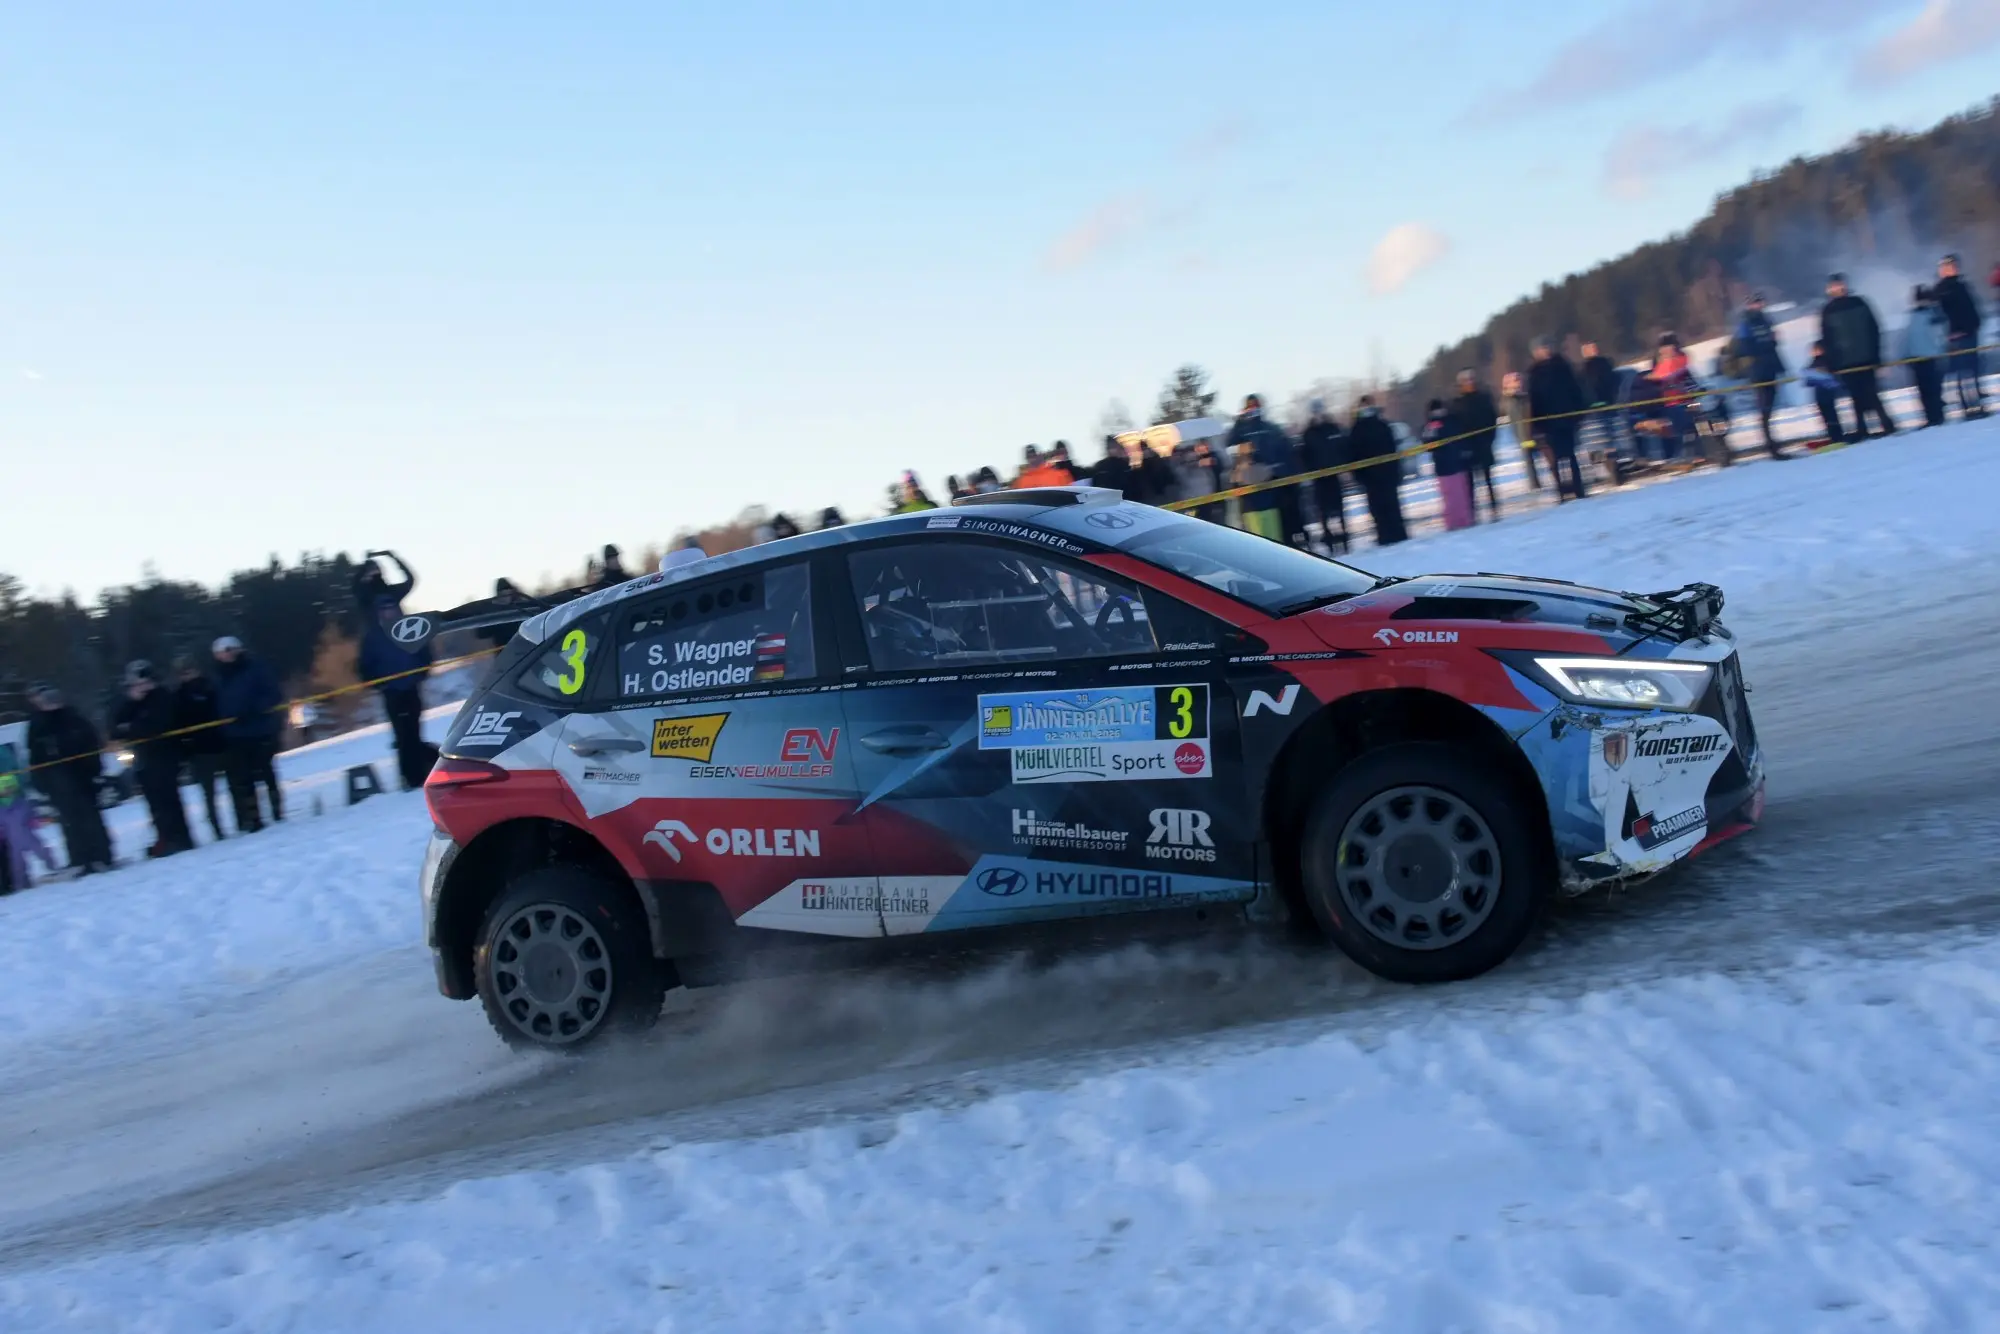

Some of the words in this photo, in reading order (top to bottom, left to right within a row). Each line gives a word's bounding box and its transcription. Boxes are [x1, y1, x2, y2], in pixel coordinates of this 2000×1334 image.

[1403, 631, 1459, 643] ORLEN
[559, 629, 586, 695] 3
[648, 644, 667, 666] S.
[675, 638, 755, 664] Wagner
[624, 674, 645, 695] H.
[652, 664, 755, 691] Ostlender
[1016, 700, 1151, 731] JÄNNERRALLYE
[1168, 687, 1193, 738] 3
[657, 721, 693, 738] inter
[659, 734, 710, 751] wetten
[1112, 753, 1166, 774] Sport
[1665, 753, 1714, 764] workwear
[1012, 808, 1128, 841] Himmelbauer
[1651, 806, 1705, 839] PRAMMER
[705, 828, 821, 857] ORLEN
[1013, 836, 1127, 851] UNTERWEITERSDORF
[1145, 845, 1216, 862] MOTORS
[1036, 872, 1172, 898] HYUNDAI
